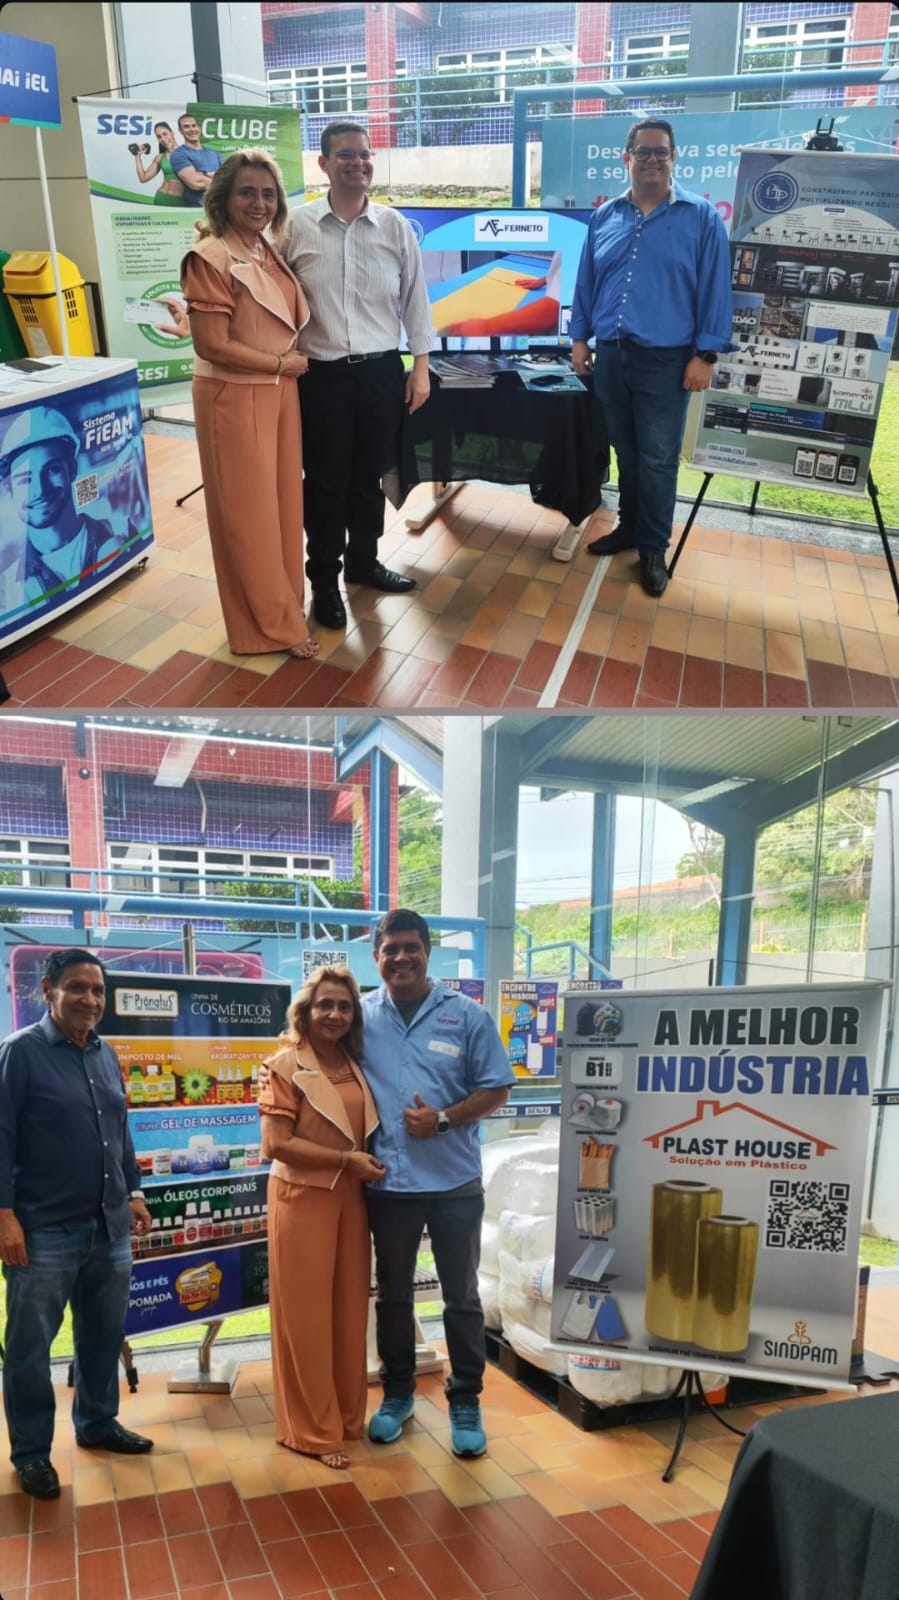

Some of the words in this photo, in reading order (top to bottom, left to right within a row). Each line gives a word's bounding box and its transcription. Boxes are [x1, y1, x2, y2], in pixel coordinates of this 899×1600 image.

[201, 118, 278, 140] CLUBE
[586, 167, 598, 179] e
[504, 224, 544, 233] FERNETO
[760, 350, 791, 359] FERNETO
[83, 411, 116, 431] Sistema
[502, 983, 536, 992] ENCONTRO
[190, 1000, 272, 1017] COSMÉTICOS
[653, 1010, 680, 1046] A
[689, 1006, 859, 1046] MELHOR
[636, 1048, 870, 1096] INDÚSTRIA
[160, 1118, 181, 1129] GEL
[184, 1117, 198, 1127] DE
[200, 1114, 257, 1126] MASSAGEM
[663, 1137, 728, 1156] PLAST
[734, 1140, 812, 1160] HOUSE
[669, 1155, 722, 1168] Solução
[725, 1159, 747, 1168] em
[163, 1188, 200, 1203] ÓLEOS
[200, 1181, 258, 1199] CORPORAIS
[147, 1278, 152, 1286] E
[153, 1274, 169, 1286] PÉS
[129, 1291, 173, 1308] POMADA
[763, 1340, 838, 1365] SINDPAM
